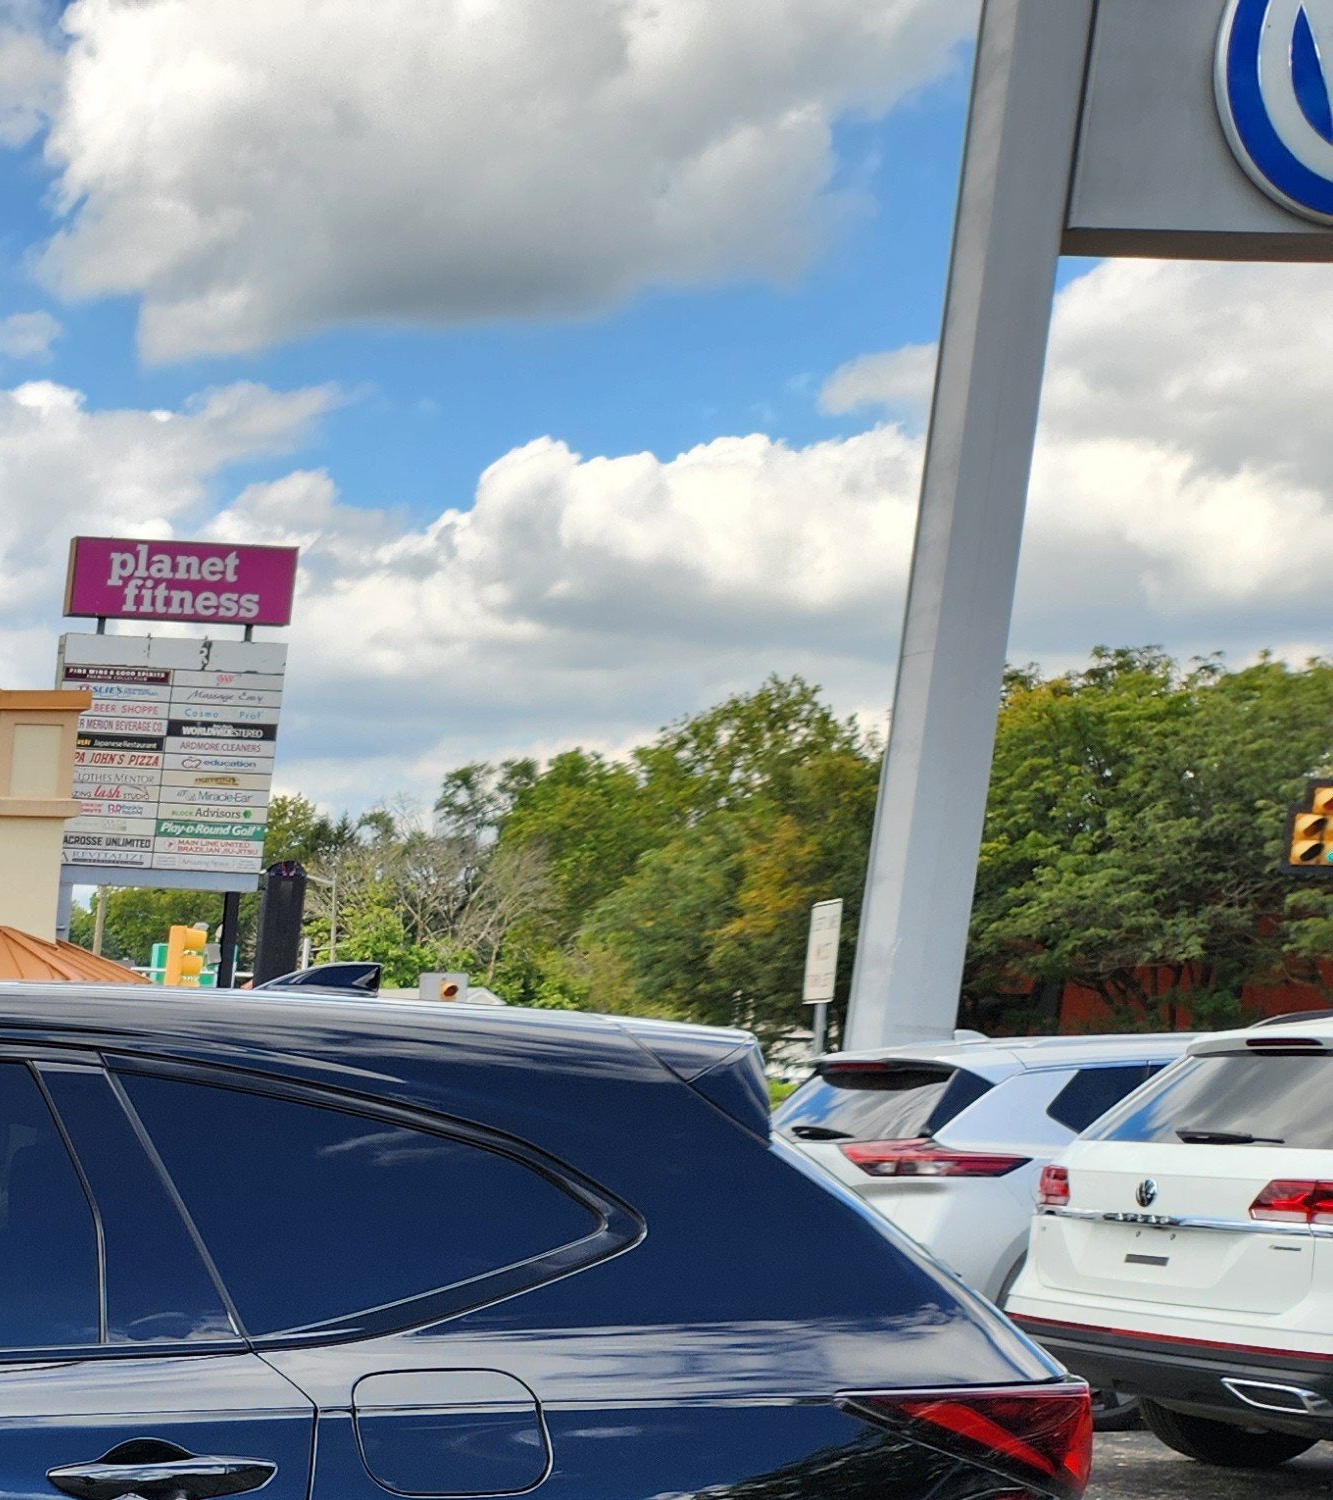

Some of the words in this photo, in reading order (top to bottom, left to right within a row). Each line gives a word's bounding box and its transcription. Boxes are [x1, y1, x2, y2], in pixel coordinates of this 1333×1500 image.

[107, 544, 240, 586] planet
[122, 579, 260, 618] fitness
[94, 703, 116, 712] BEER
[121, 705, 159, 715] SHOPPE
[184, 708, 219, 718] Cosmo
[86, 719, 113, 731] MERION
[115, 720, 151, 732] BEVERAGE
[179, 741, 220, 751] ARDMORE
[221, 743, 261, 753] CLEANERS
[90, 753, 125, 765] JOHN'S
[128, 755, 160, 767] PIZZA
[203, 759, 256, 767] education
[194, 808, 241, 819] Advisors
[232, 825, 256, 836] Golf
[105, 837, 151, 849] UNLIMITED
